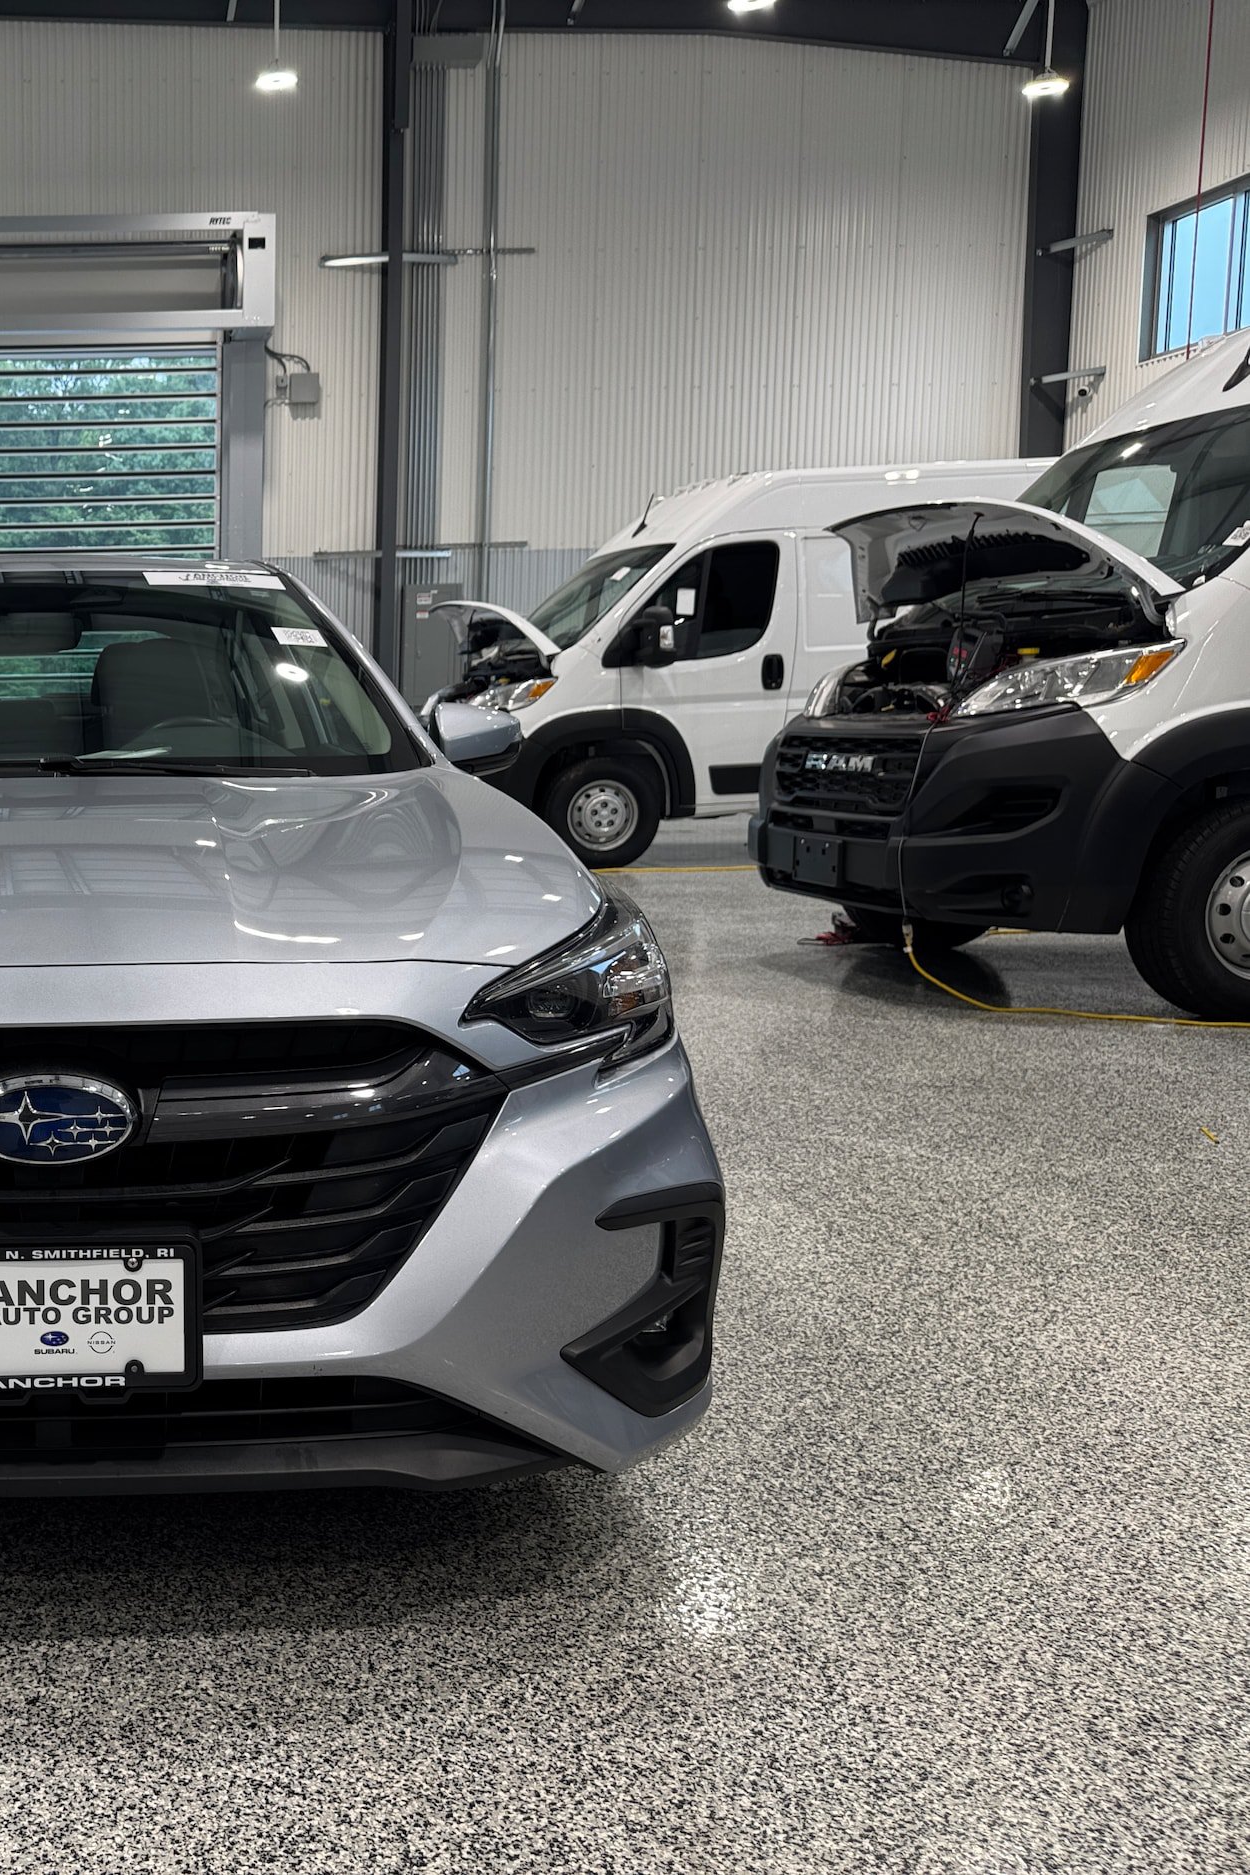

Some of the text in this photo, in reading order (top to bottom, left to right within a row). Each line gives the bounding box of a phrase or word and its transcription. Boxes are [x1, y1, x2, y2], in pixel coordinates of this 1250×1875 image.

[805, 753, 875, 772] RAM
[5, 1250, 25, 1260] N.
[156, 1247, 175, 1258] RI
[71, 1306, 175, 1325] GROUP
[33, 1347, 76, 1355] SUBARU
